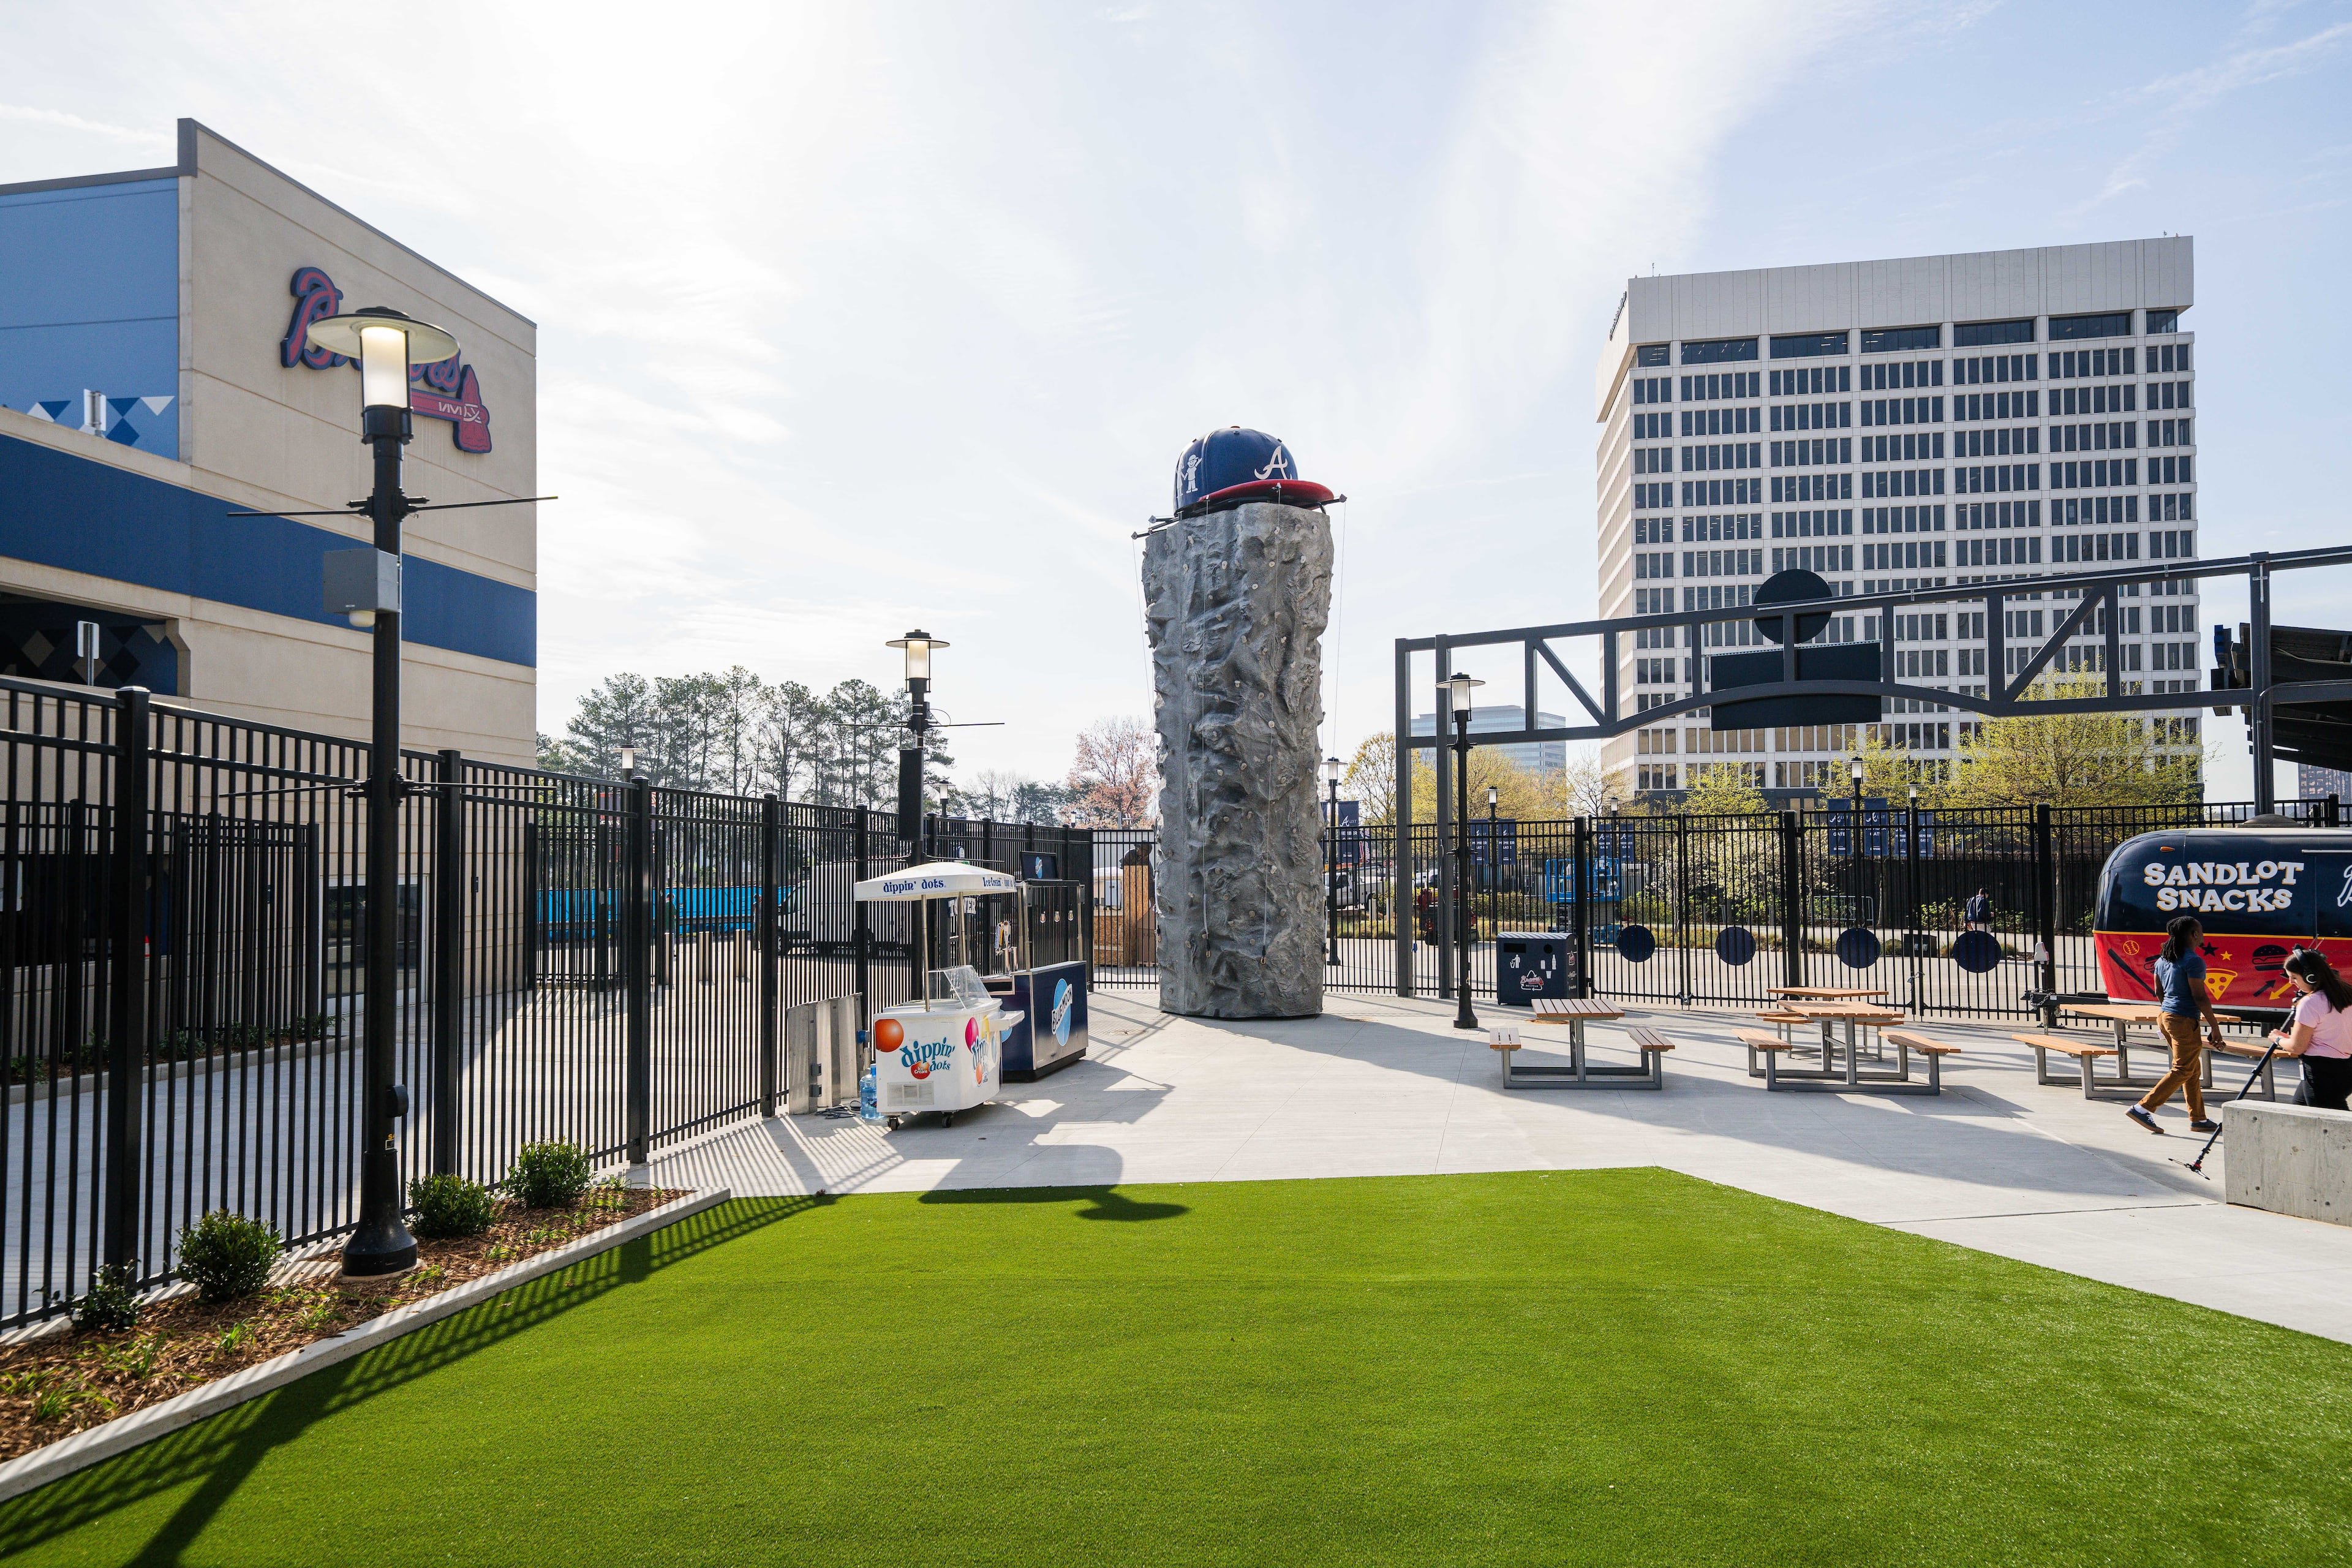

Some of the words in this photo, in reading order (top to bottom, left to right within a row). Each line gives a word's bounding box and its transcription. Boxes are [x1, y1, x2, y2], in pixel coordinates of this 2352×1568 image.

[1254, 445, 1292, 480] A
[1340, 815, 1349, 827] A
[2144, 861, 2304, 886] SANDLOT
[883, 880, 916, 894] dippin'
[922, 878, 944, 889] dots
[2157, 888, 2293, 912] SNACKS
[1052, 1005, 1062, 1033] BLUE
[1063, 987, 1072, 1013] MOON
[899, 1037, 955, 1068] dippin'
[929, 1060, 950, 1072] dots
